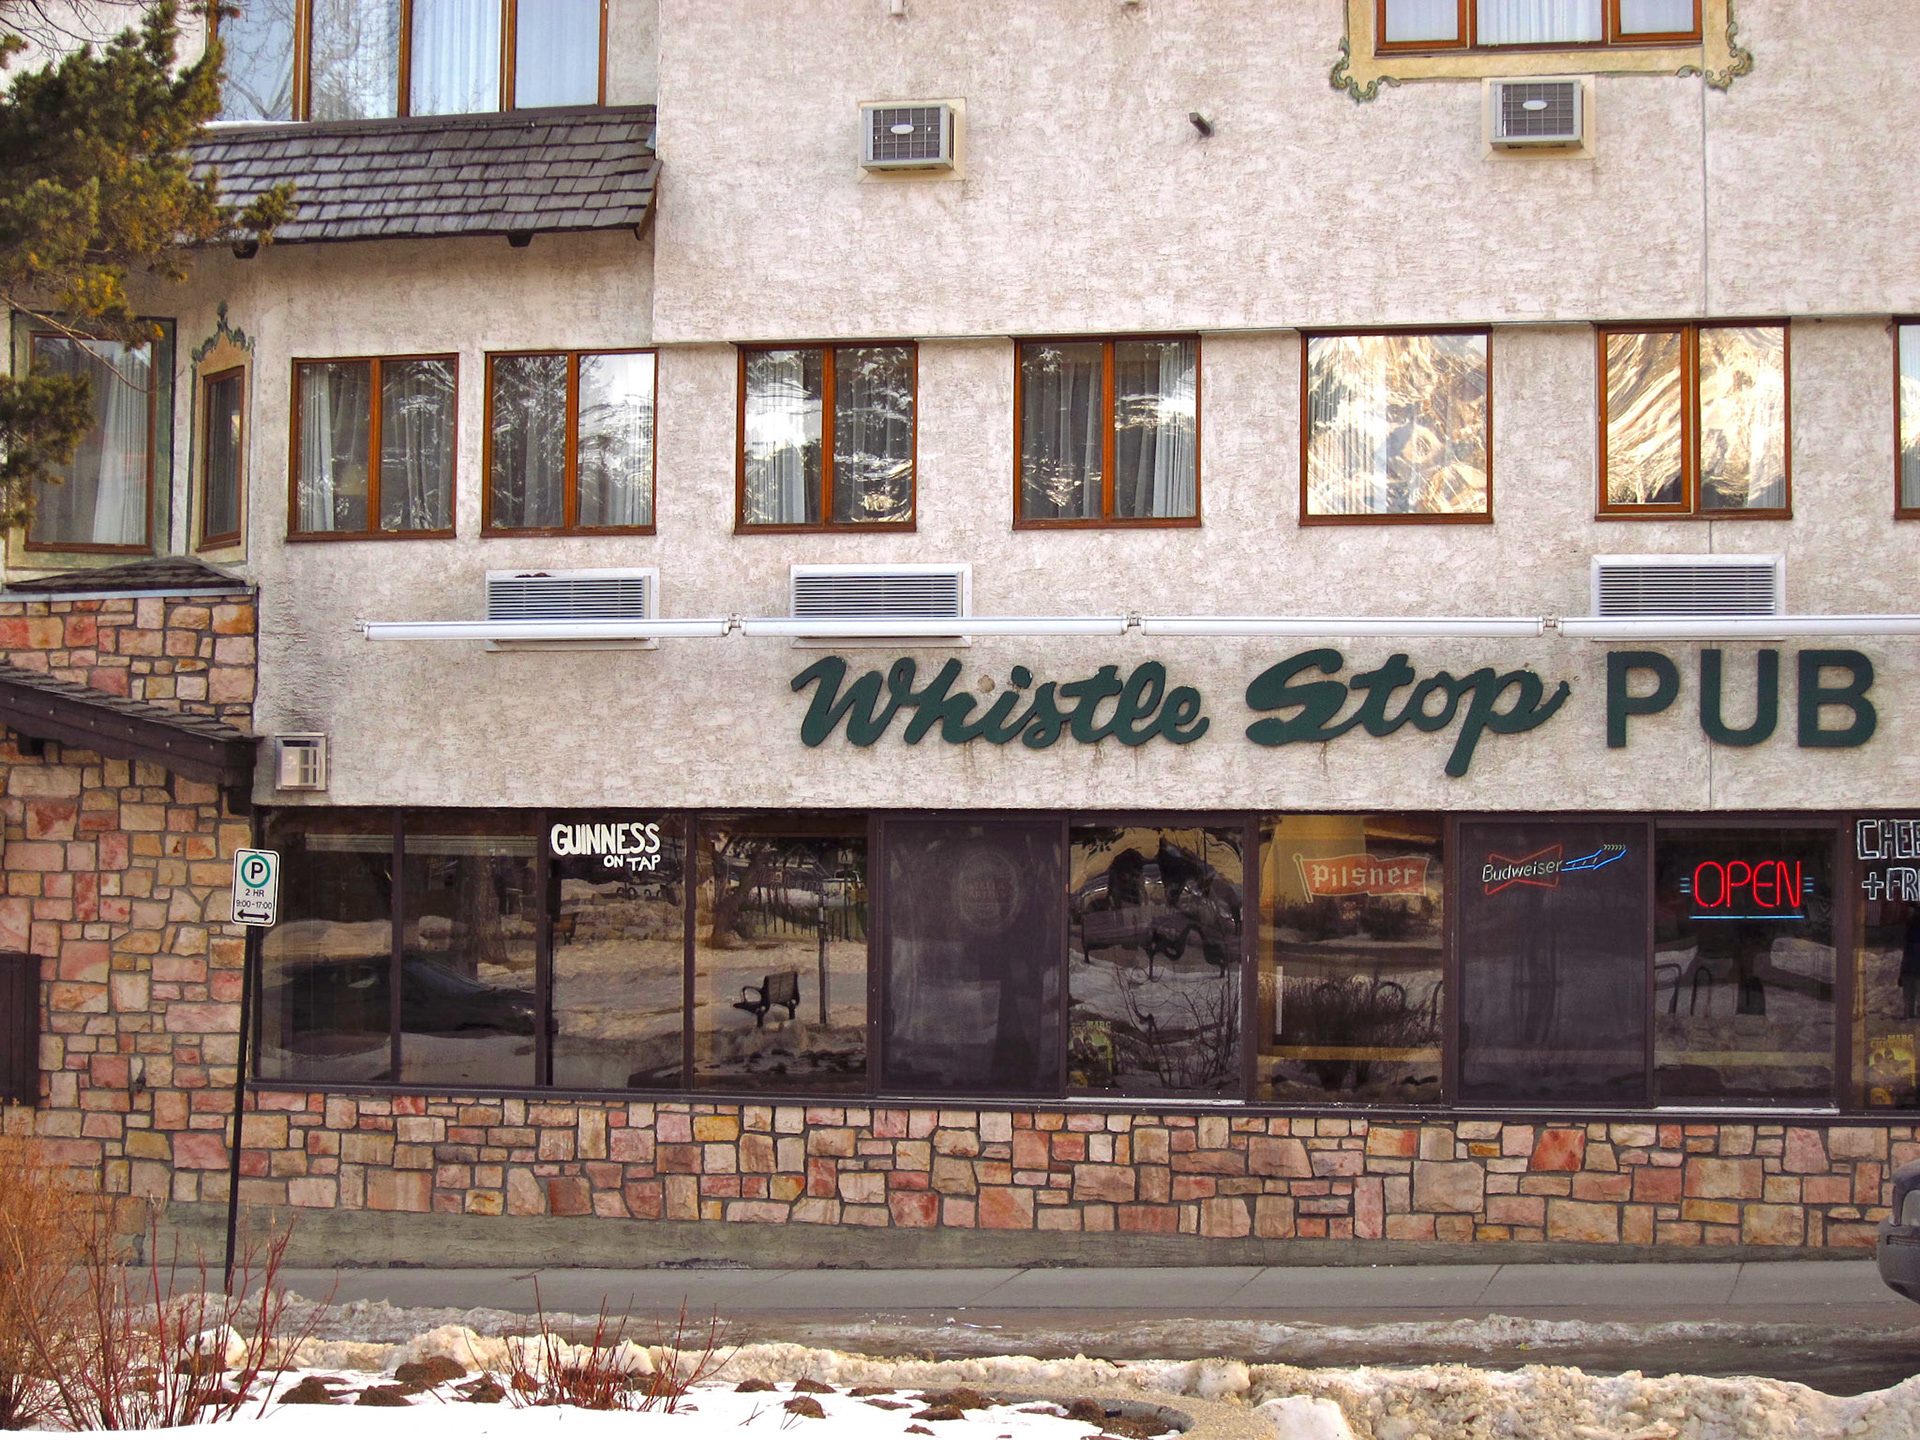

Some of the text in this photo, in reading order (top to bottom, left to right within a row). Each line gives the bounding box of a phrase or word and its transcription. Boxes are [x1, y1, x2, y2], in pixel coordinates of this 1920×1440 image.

[790, 649, 1877, 777] Whistle Stop PUB
[550, 823, 661, 856] GUINNESS
[250, 861, 264, 879] P
[603, 854, 661, 871] ON TAP
[1482, 859, 1563, 883] Budweiser
[1311, 863, 1418, 888] Pilsner
[1694, 860, 1801, 907] OPEN
[245, 888, 265, 897] 2 HR
